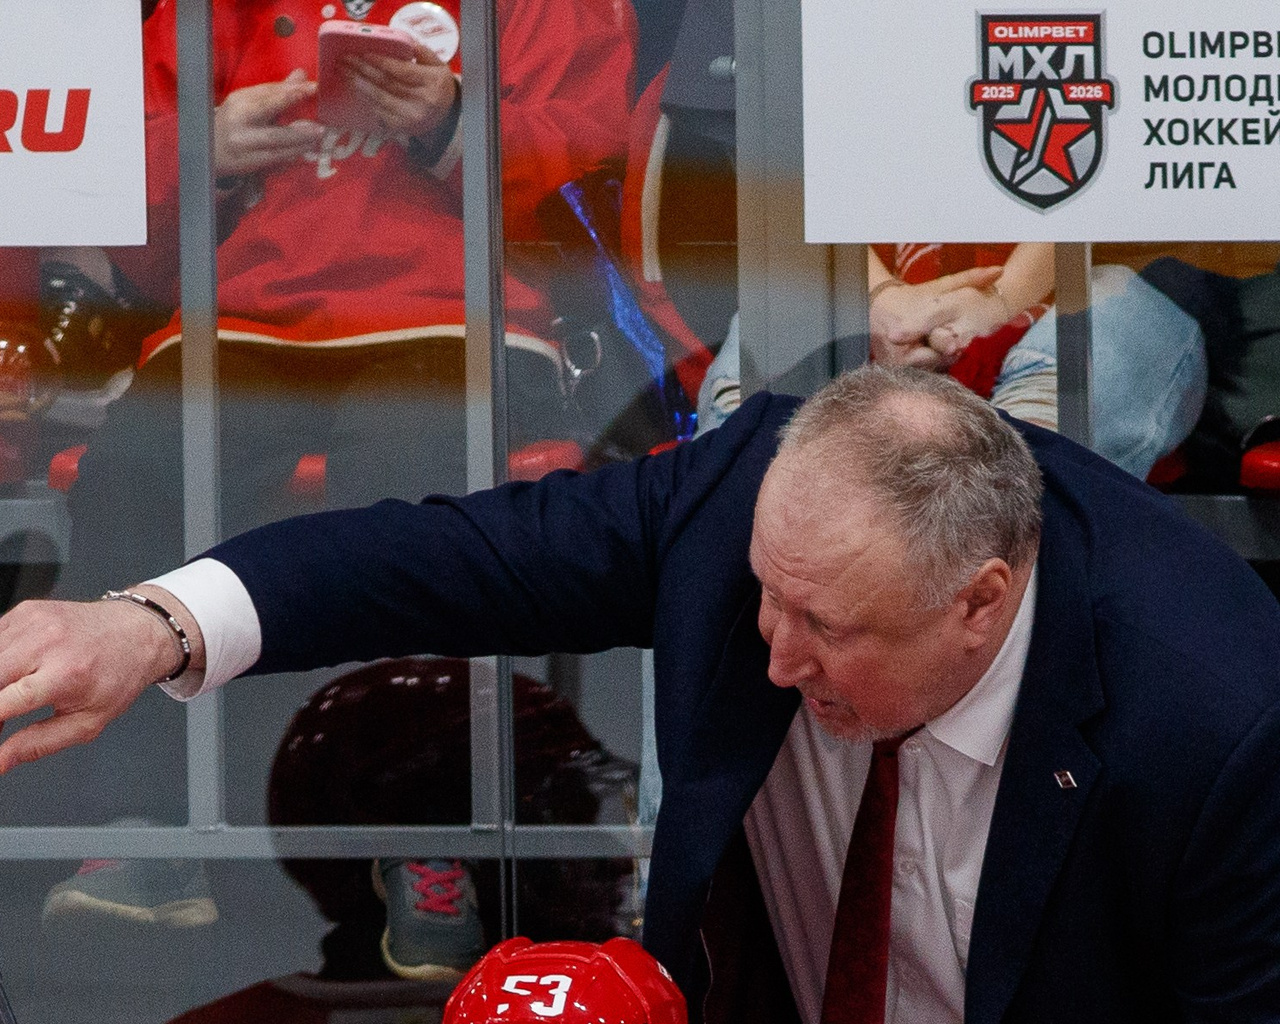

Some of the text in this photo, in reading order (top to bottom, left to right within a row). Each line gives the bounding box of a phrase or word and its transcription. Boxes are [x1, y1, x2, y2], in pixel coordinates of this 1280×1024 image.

[994, 25, 1087, 39] OLIMPBET
[1142, 31, 1280, 59] OLIMPB
[988, 45, 1095, 80] МХЛ
[981, 85, 1103, 99] 2025 2026
[1143, 74, 1280, 107] МОЛОД
[1144, 161, 1237, 189] ЛИГА
[501, 974, 573, 1017] 53
